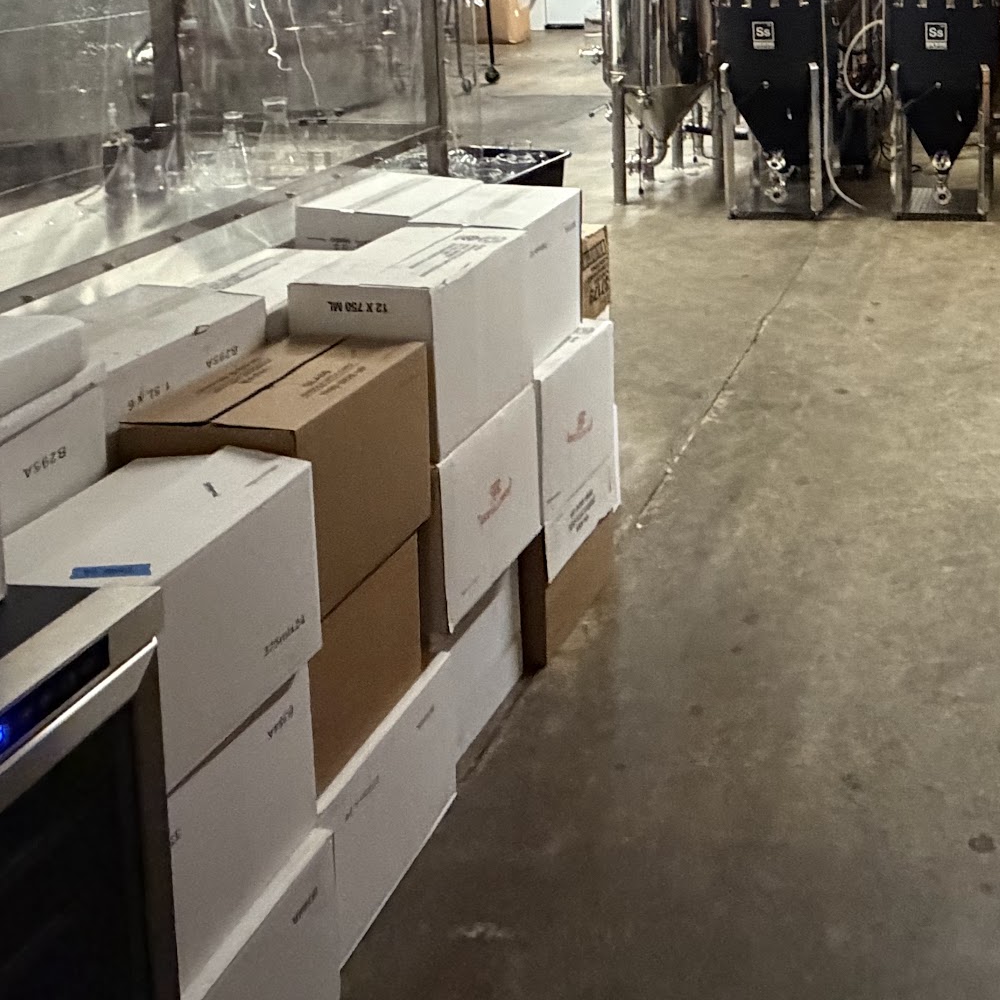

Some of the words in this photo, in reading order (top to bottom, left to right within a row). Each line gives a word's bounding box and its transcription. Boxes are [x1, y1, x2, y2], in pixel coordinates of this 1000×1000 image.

[755, 26, 771, 38] Ss
[928, 26, 944, 38] Ss
[327, 301, 343, 312] ML
[345, 301, 363, 313] 750
[375, 302, 388, 313] 12
[23, 446, 67, 479] B295A
